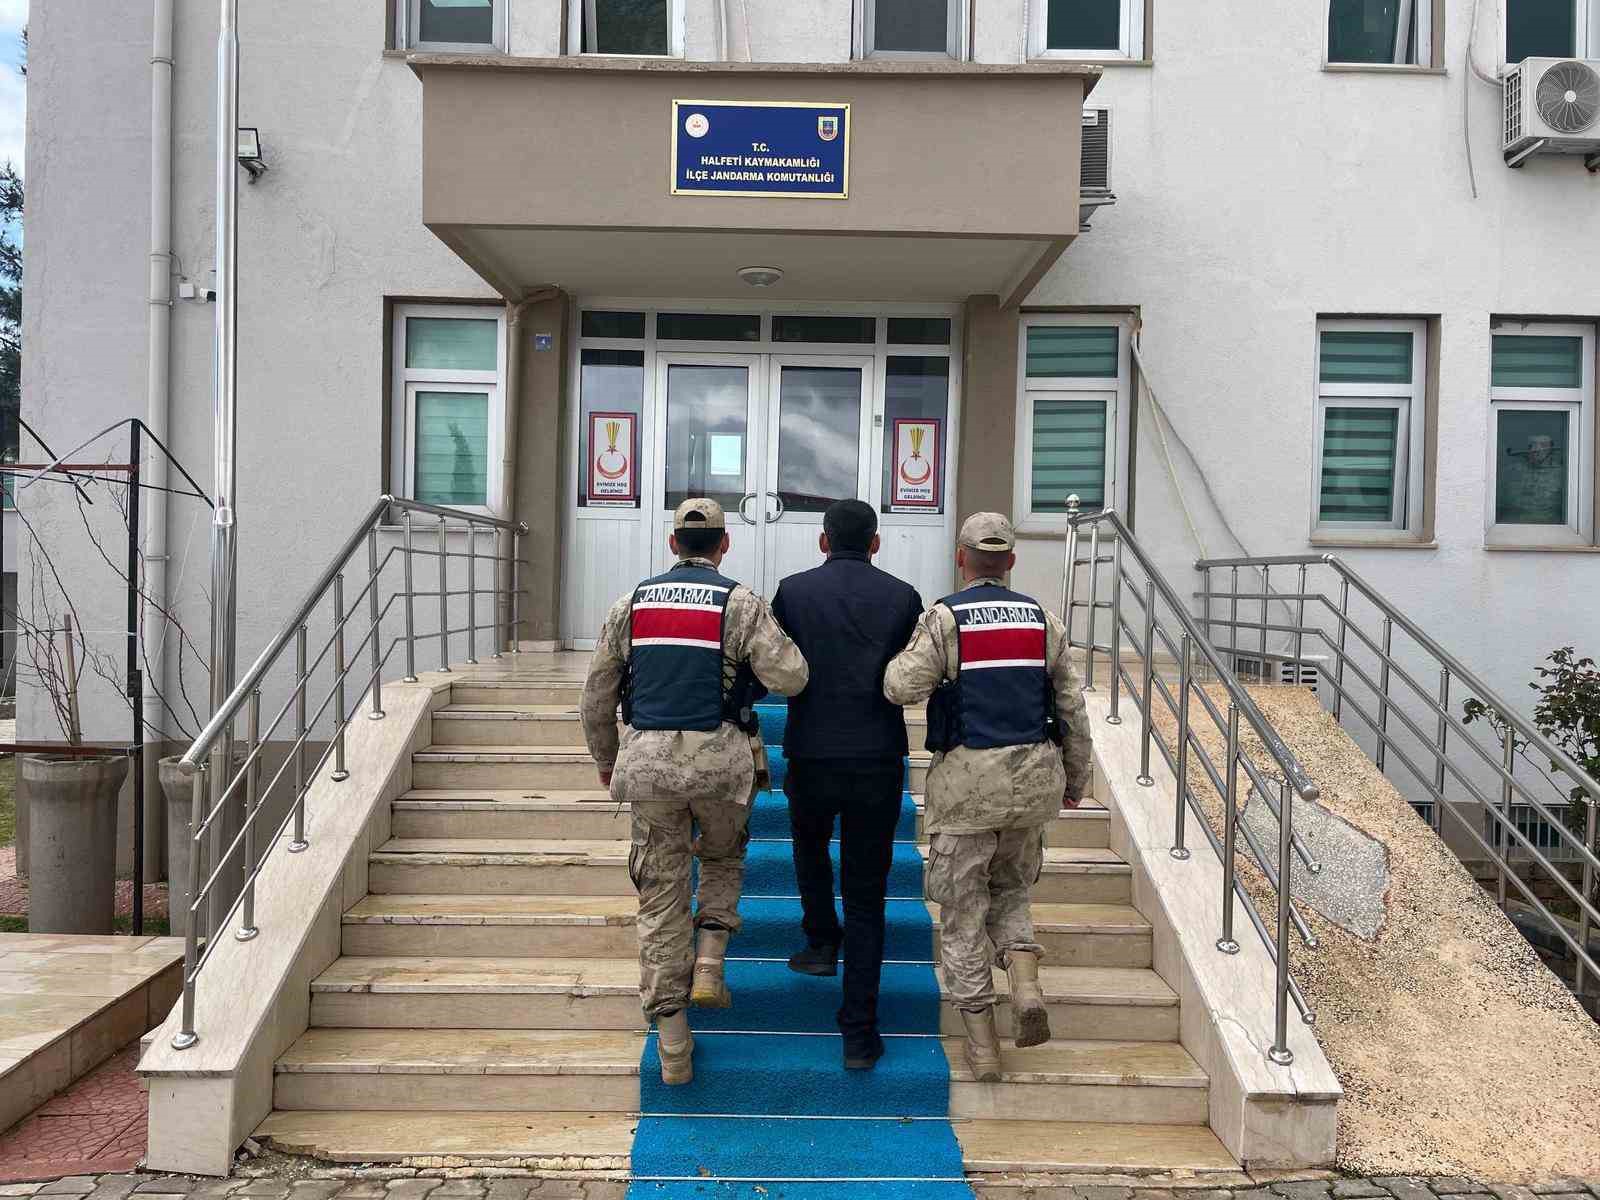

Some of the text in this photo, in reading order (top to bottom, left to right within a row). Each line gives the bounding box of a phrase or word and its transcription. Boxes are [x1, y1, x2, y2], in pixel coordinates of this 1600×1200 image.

[751, 143, 770, 152] T.C.
[701, 155, 820, 168] HALFETİ KAYMAKAMLIĞI
[686, 168, 834, 183] İLÇE JANDARMA KOMUTANLIĞI
[640, 586, 714, 605] JANDARMA
[966, 607, 1038, 625] JANDARMA
